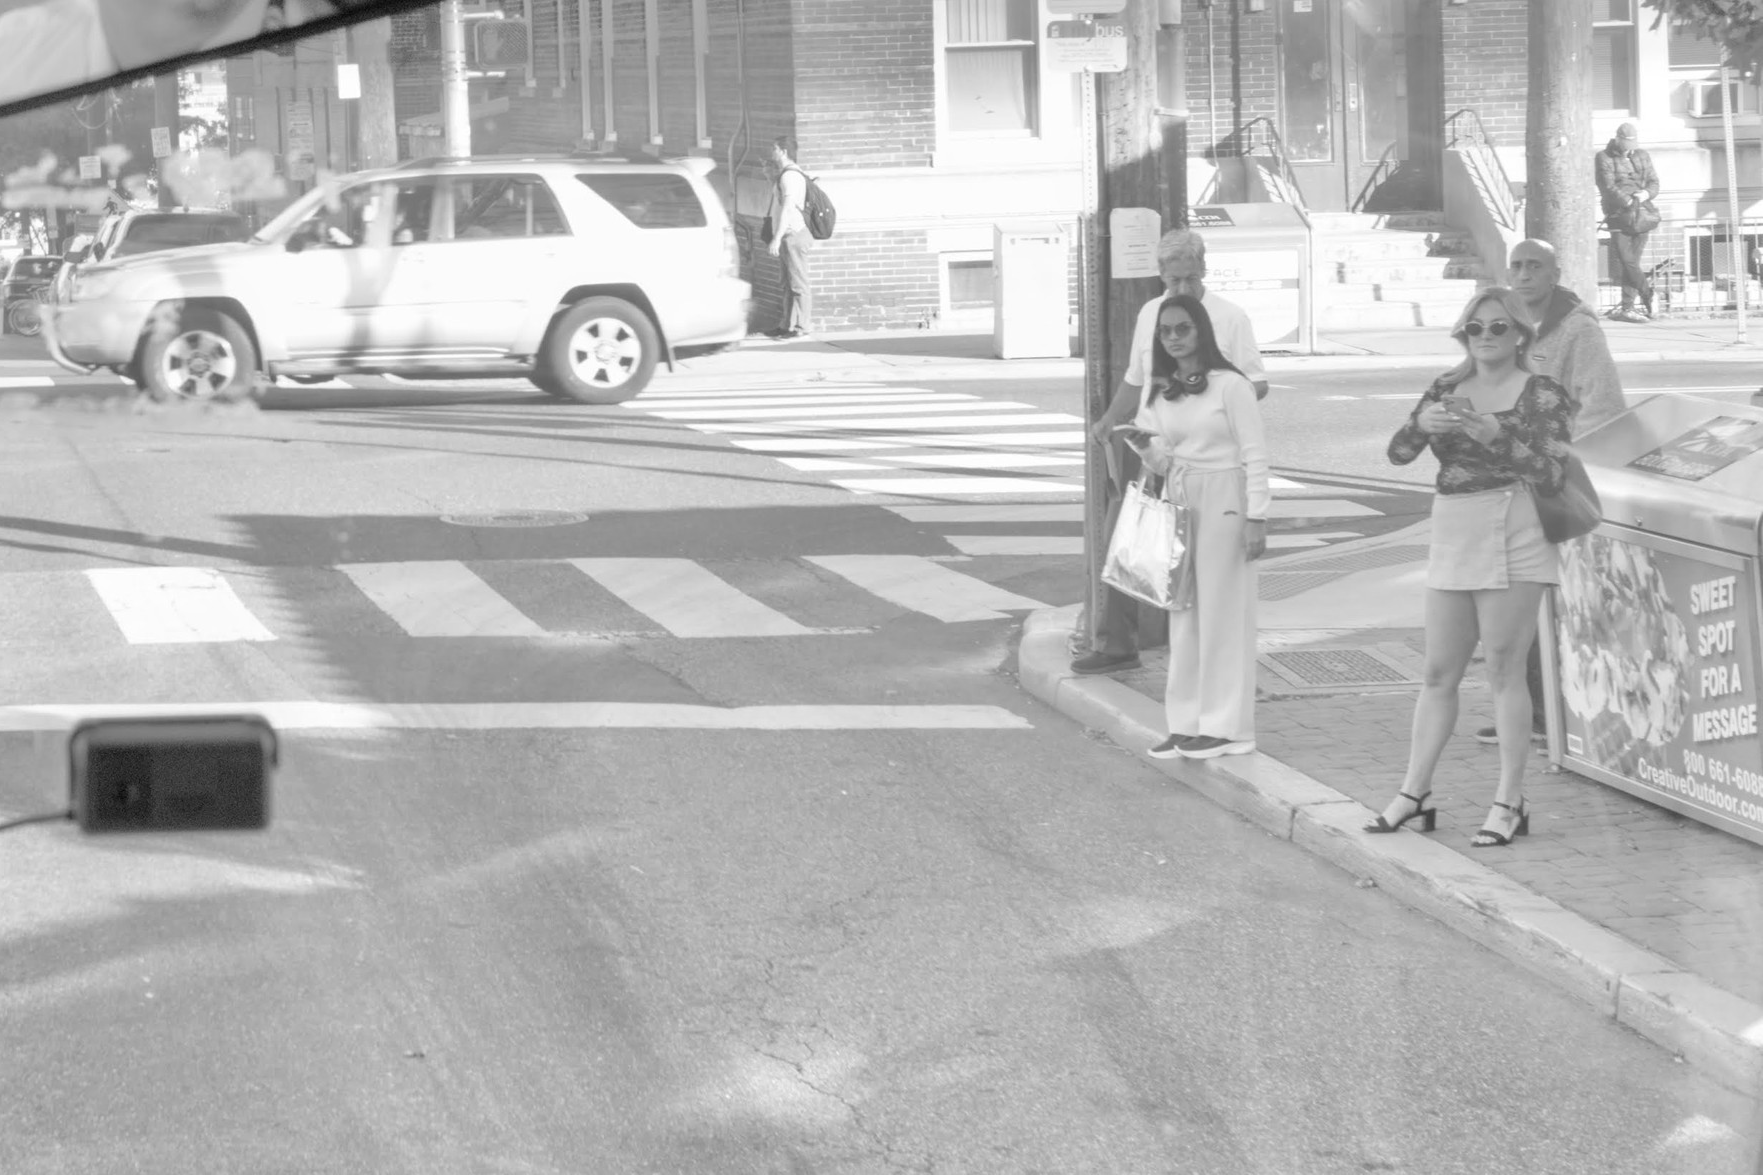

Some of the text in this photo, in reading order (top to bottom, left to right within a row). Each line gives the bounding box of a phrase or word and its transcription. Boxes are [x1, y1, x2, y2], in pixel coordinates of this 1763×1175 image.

[1690, 575, 1737, 616] SWEET
[1698, 620, 1736, 657] SPOT
[1701, 663, 1742, 699] FOR A
[1692, 703, 1758, 743] MESSAGE
[1683, 749, 1706, 776] 800
